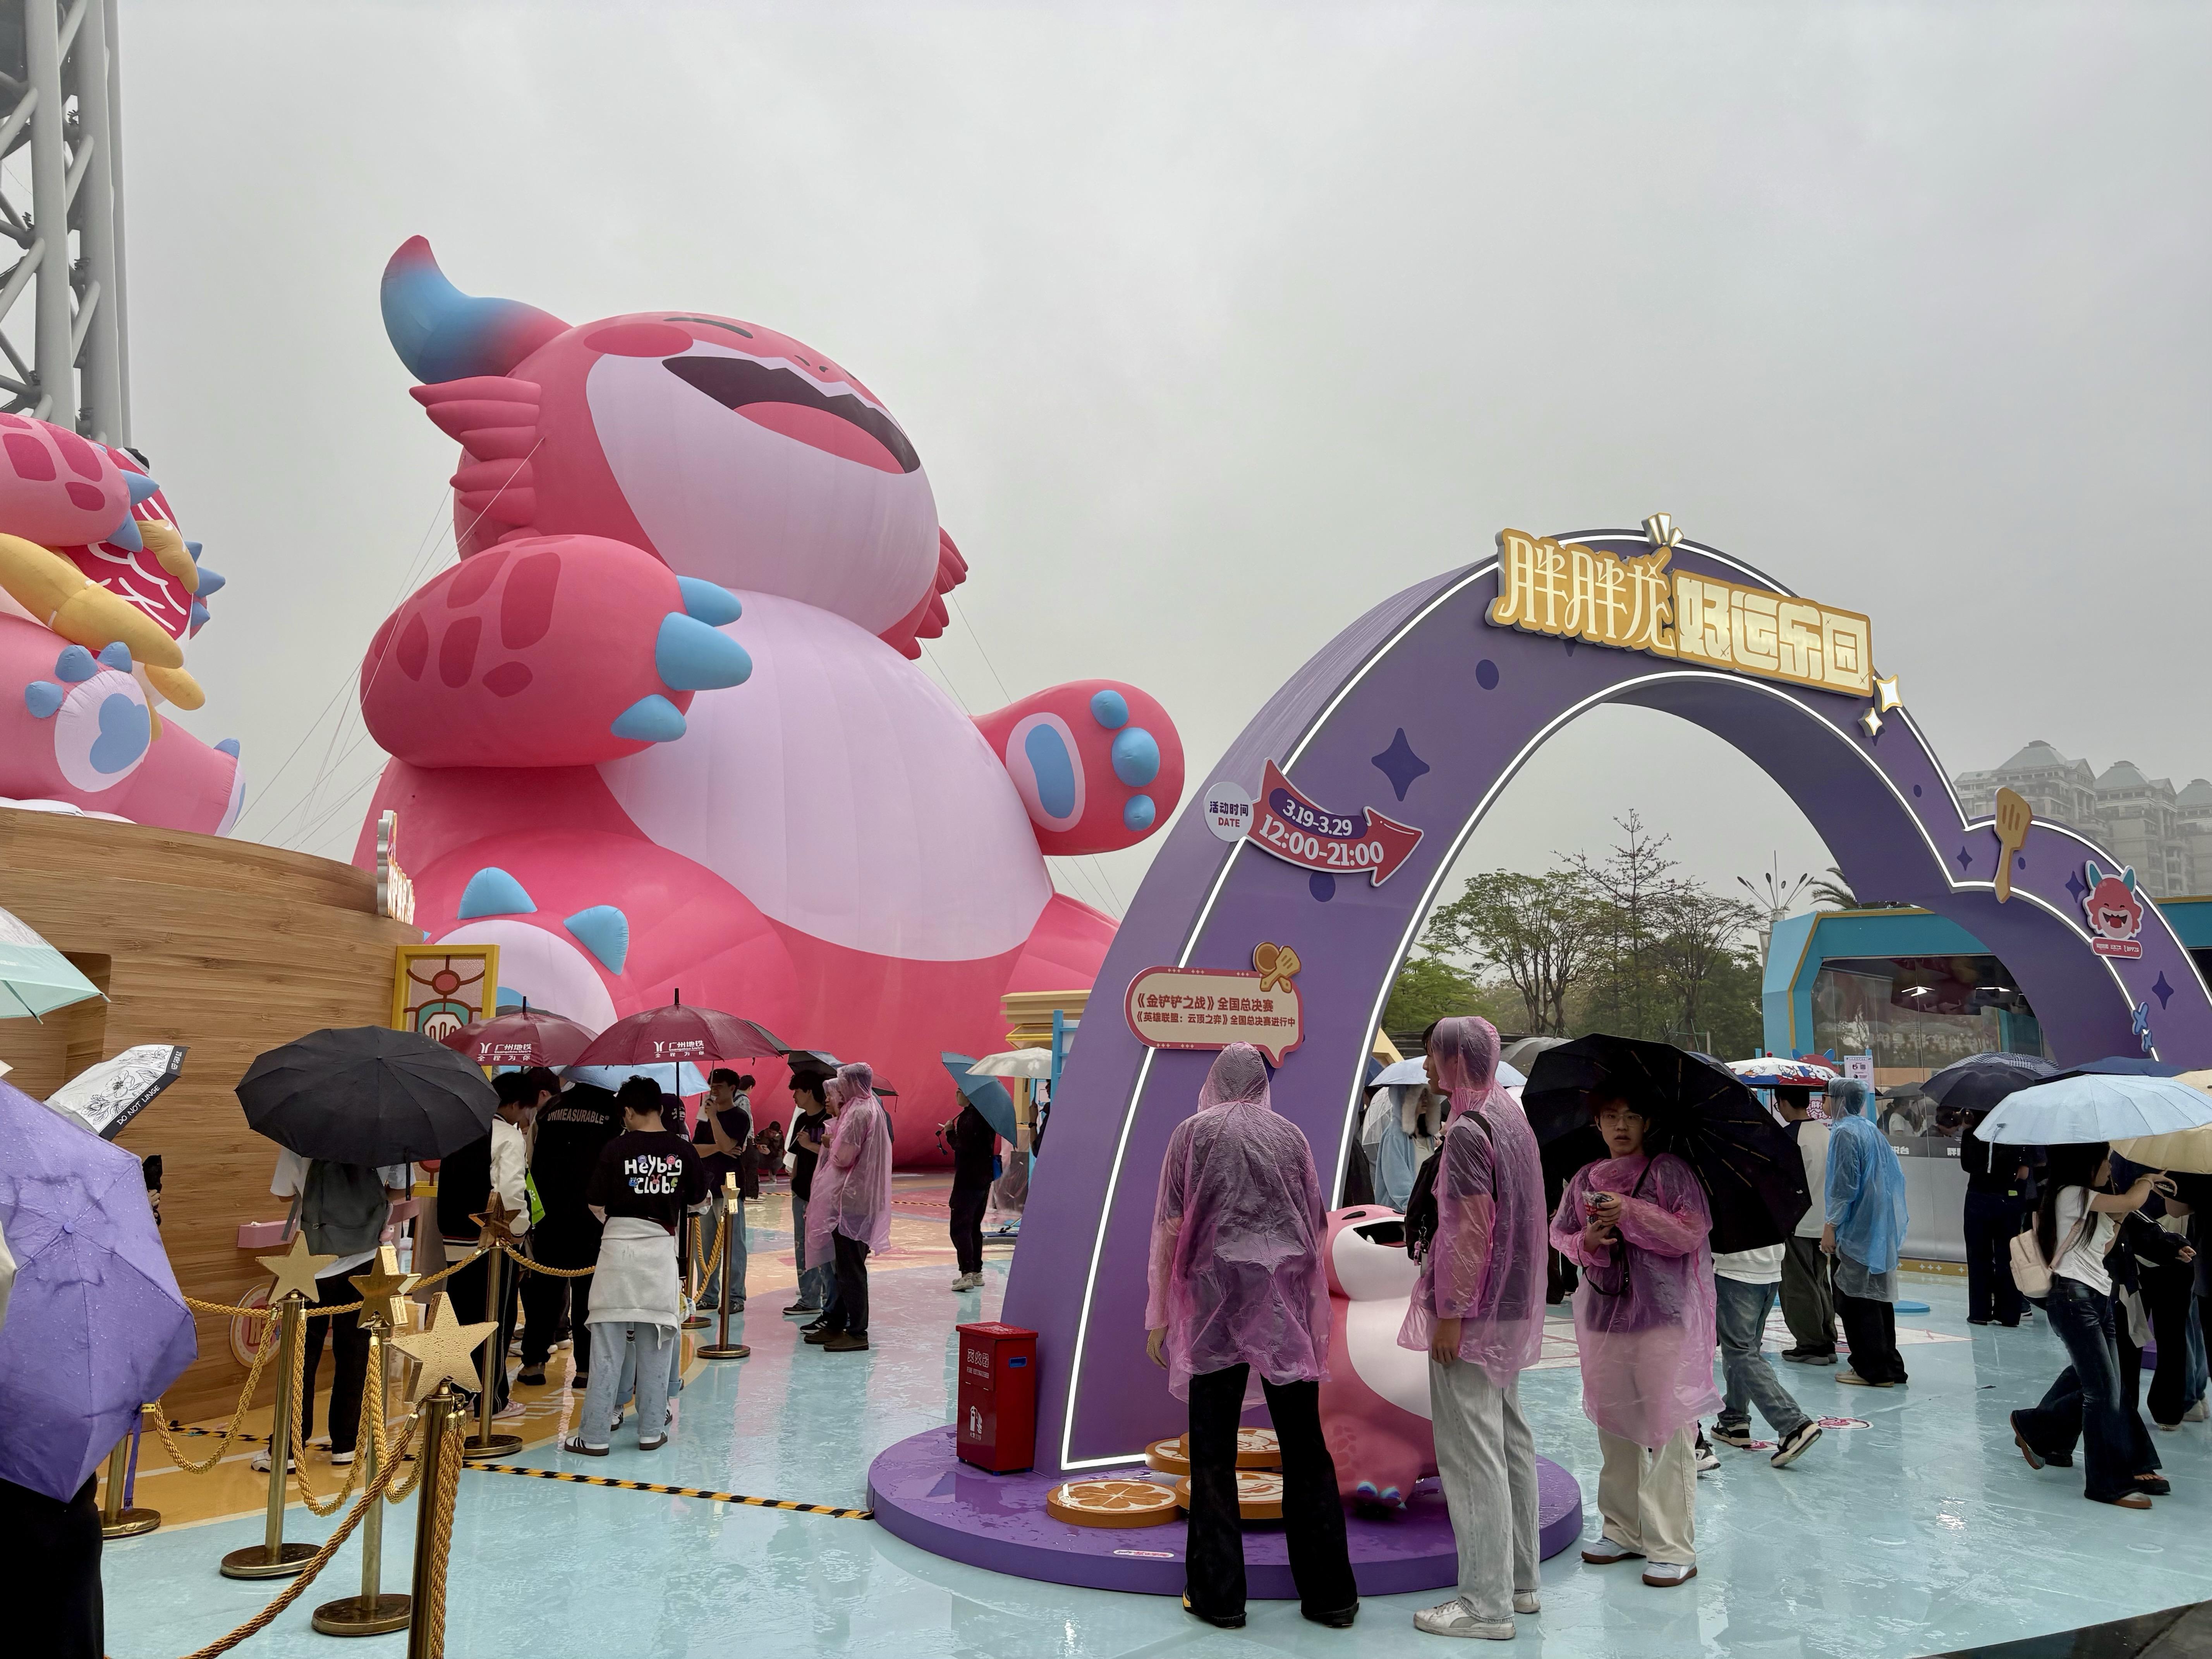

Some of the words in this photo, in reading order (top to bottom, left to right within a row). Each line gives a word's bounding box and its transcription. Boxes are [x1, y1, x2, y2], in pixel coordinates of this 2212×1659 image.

[1209, 801, 1249, 817] 活动时间
[1282, 799, 1353, 836] 3.19-3.29
[1218, 817, 1240, 828] DATE
[1259, 814, 1384, 866] 12:00-21:00
[669, 1040, 704, 1048] 广州地铁
[117, 1115, 127, 1125] DO
[127, 1101, 141, 1116] NOT
[967, 1348, 989, 1368] 灭火器
